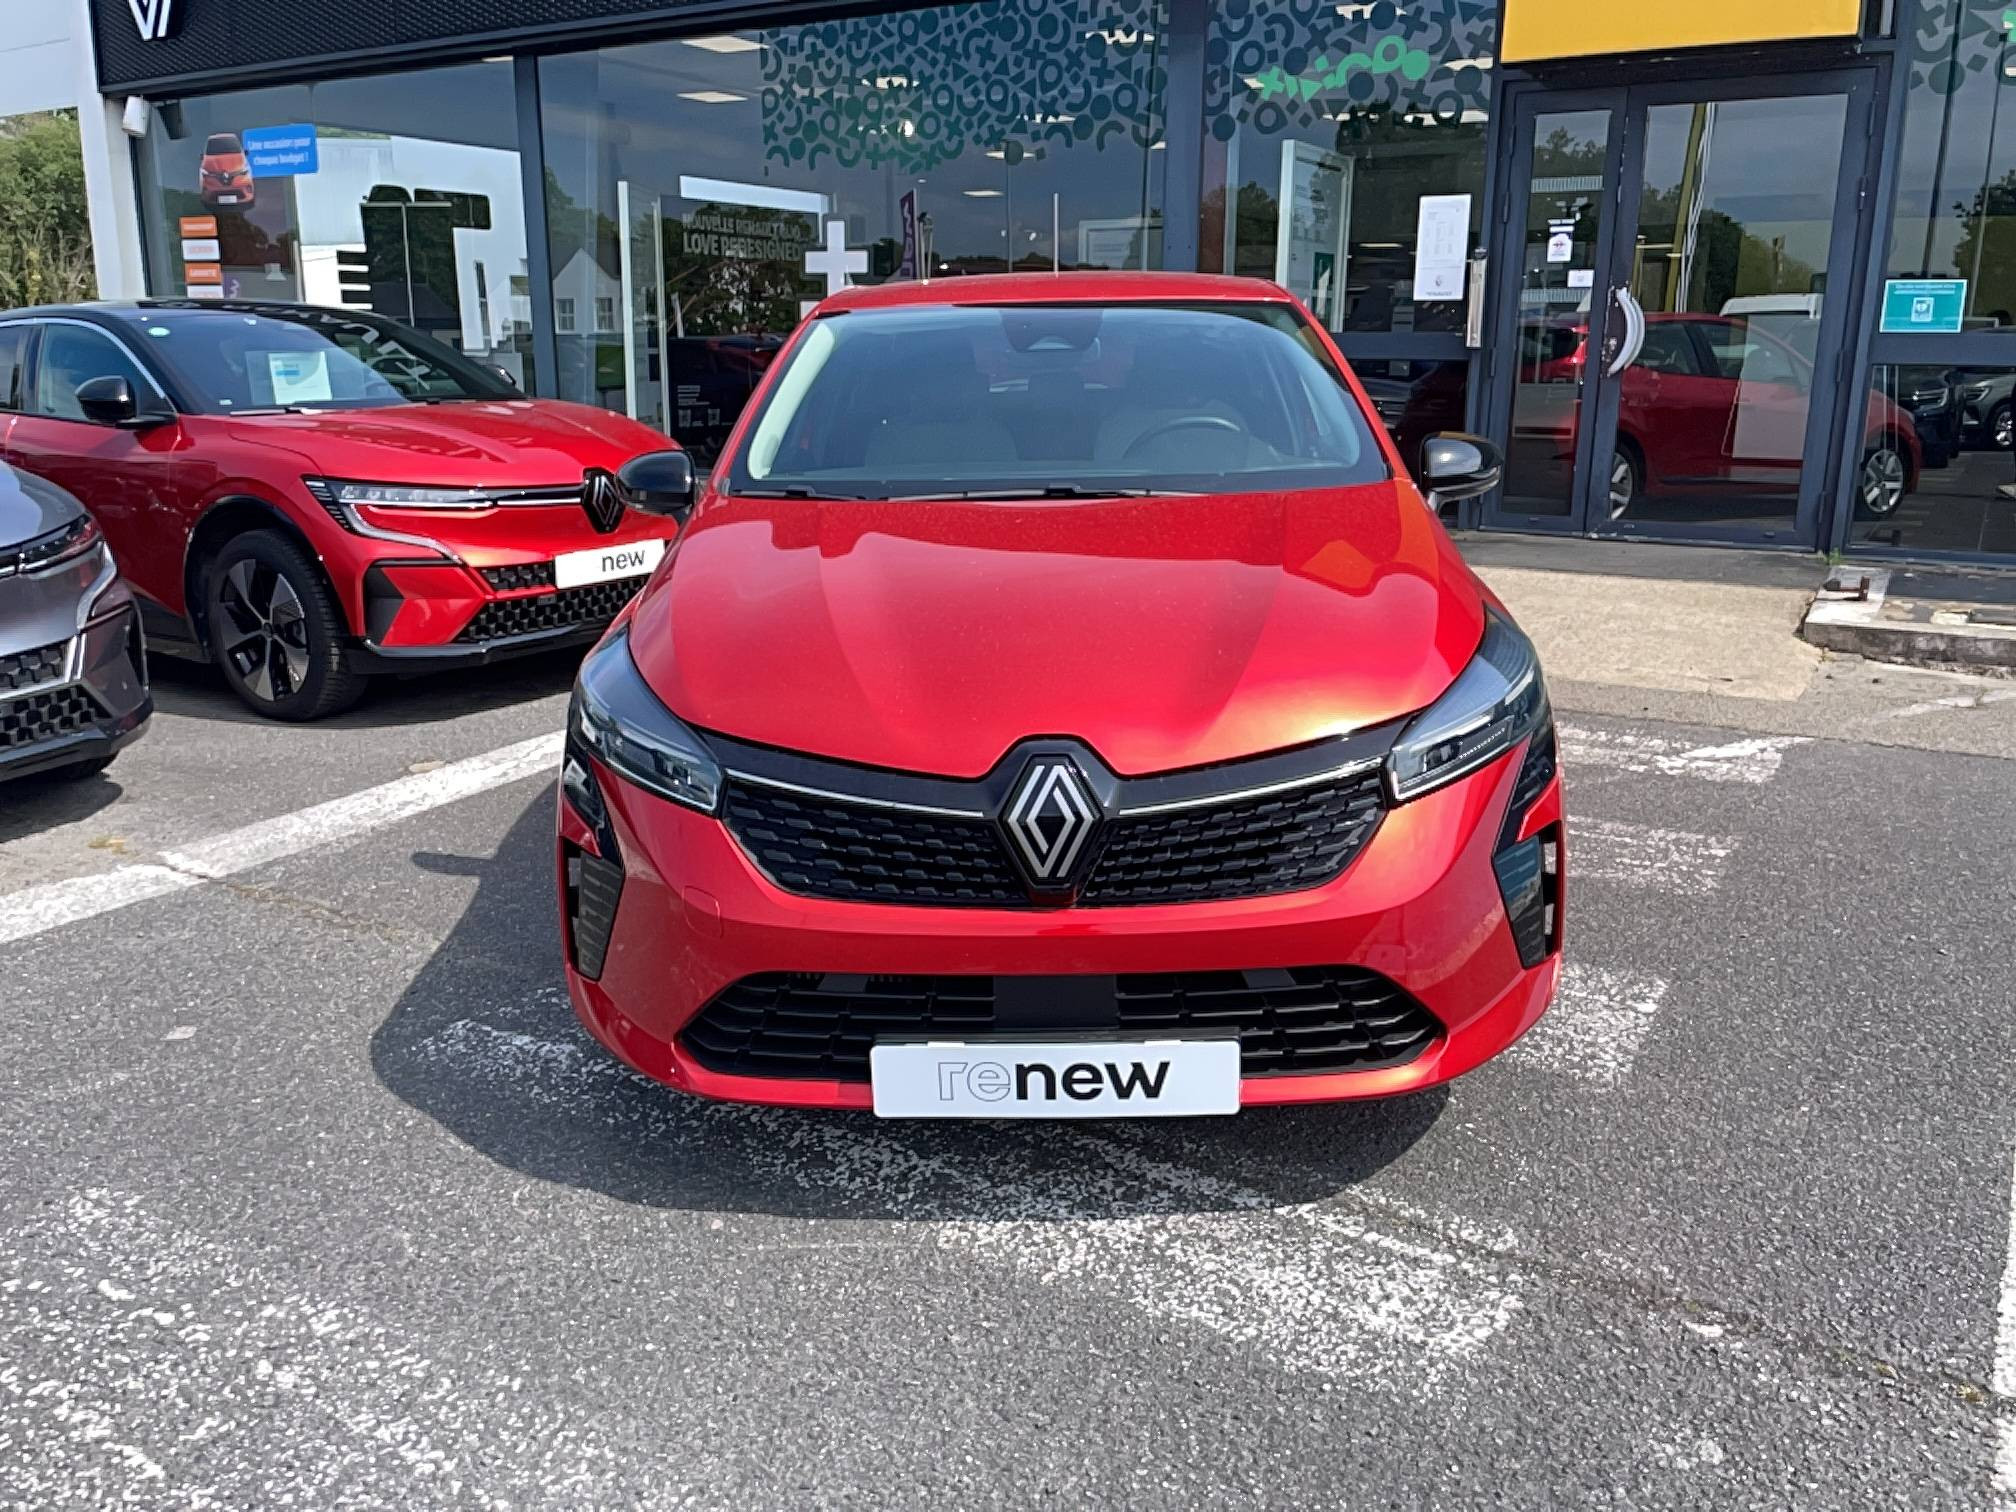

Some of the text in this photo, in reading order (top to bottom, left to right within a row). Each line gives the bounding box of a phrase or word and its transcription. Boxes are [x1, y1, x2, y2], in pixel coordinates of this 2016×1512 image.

[682, 232, 720, 256] LOVE
[602, 550, 645, 571] new
[937, 1061, 1171, 1101] renew
